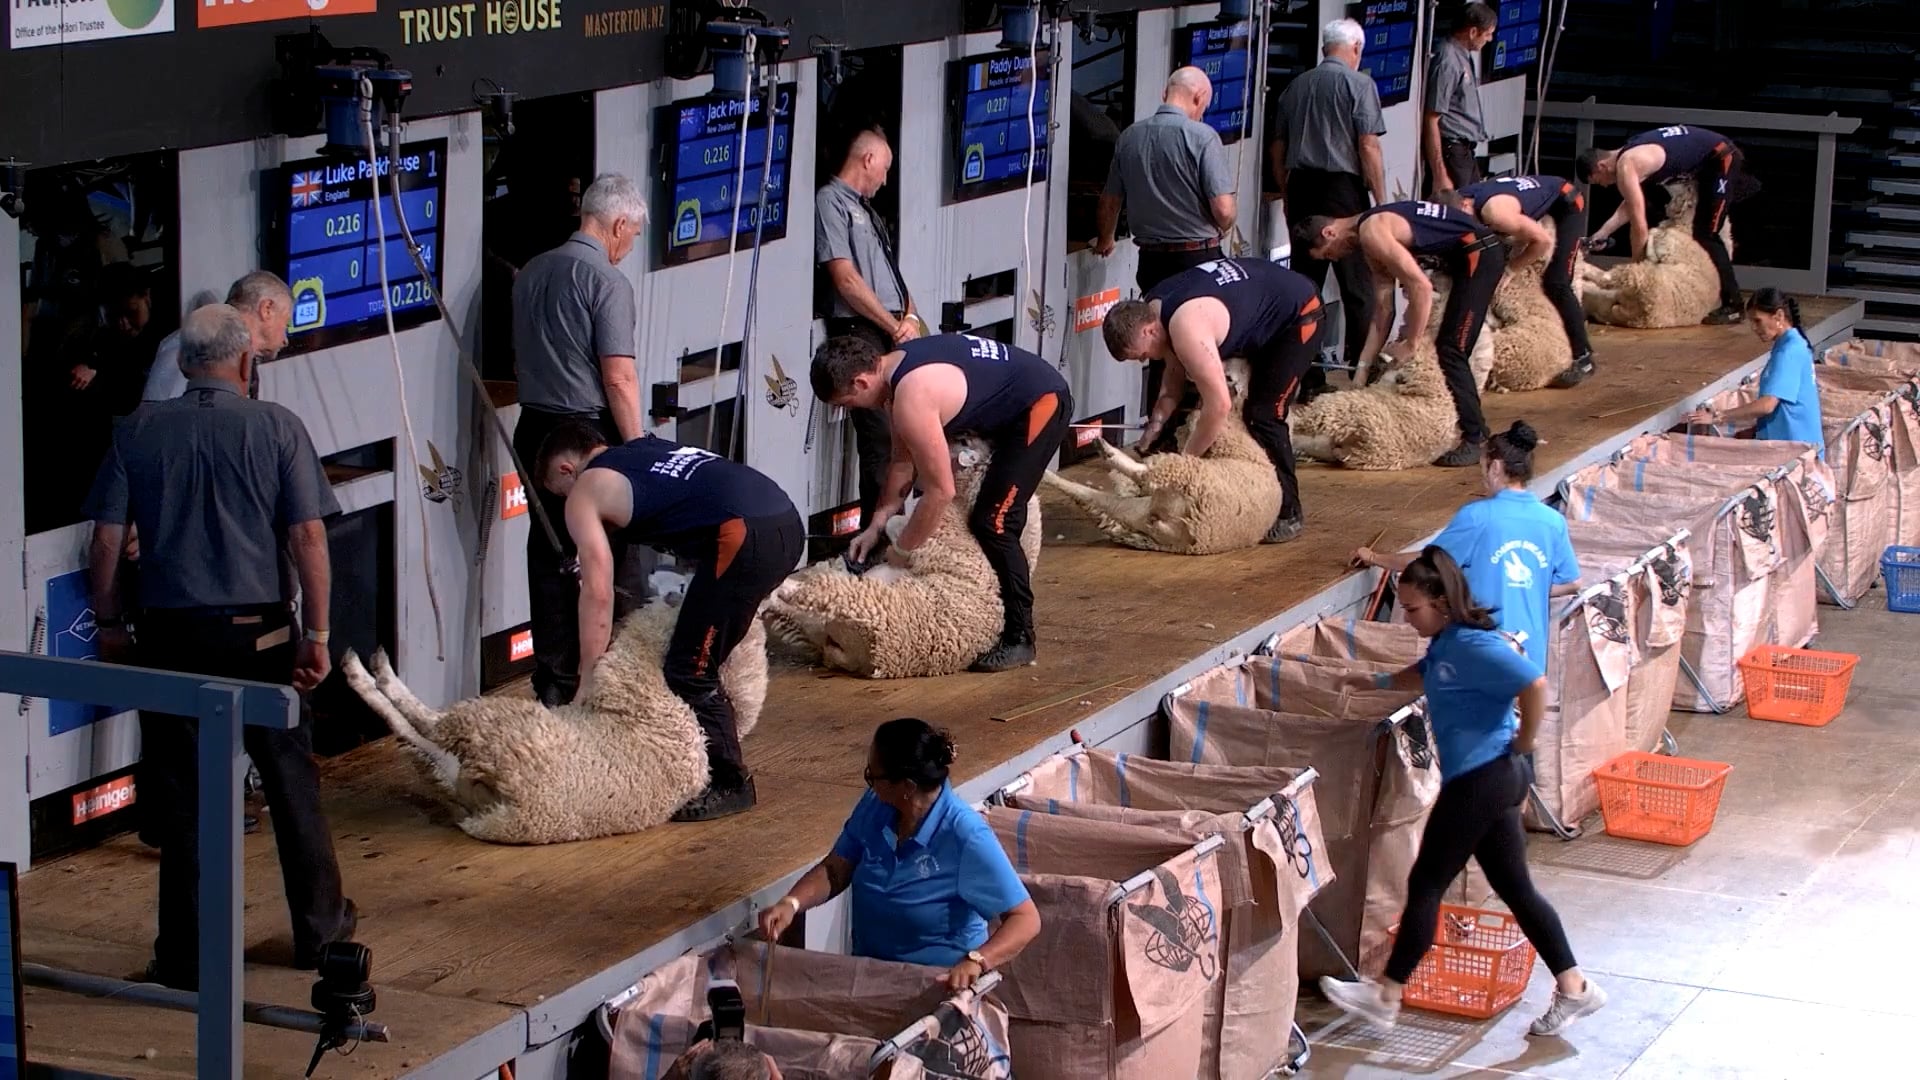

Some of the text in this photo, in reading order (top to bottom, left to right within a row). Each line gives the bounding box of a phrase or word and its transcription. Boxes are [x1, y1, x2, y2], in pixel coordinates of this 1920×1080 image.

[15, 27, 35, 39] Office
[36, 25, 43, 36] of
[45, 23, 56, 35] the
[79, 20, 105, 31] Trustee
[400, 3, 476, 44] TRUST
[584, 5, 665, 38] MASTERTON.NZ
[990, 57, 1012, 74] Paddy
[706, 101, 727, 124] Jack
[986, 96, 1008, 113] 0.217
[704, 144, 729, 165] 0.216
[326, 163, 355, 185] Luke
[428, 150, 437, 178] 1
[325, 188, 350, 202] England
[326, 213, 361, 237] 0.216
[425, 200, 433, 219] 0
[351, 259, 359, 279] 0
[368, 280, 433, 313] TOTA 0.216
[649, 461, 665, 473] TE
[76, 782, 137, 819] Heiniger
